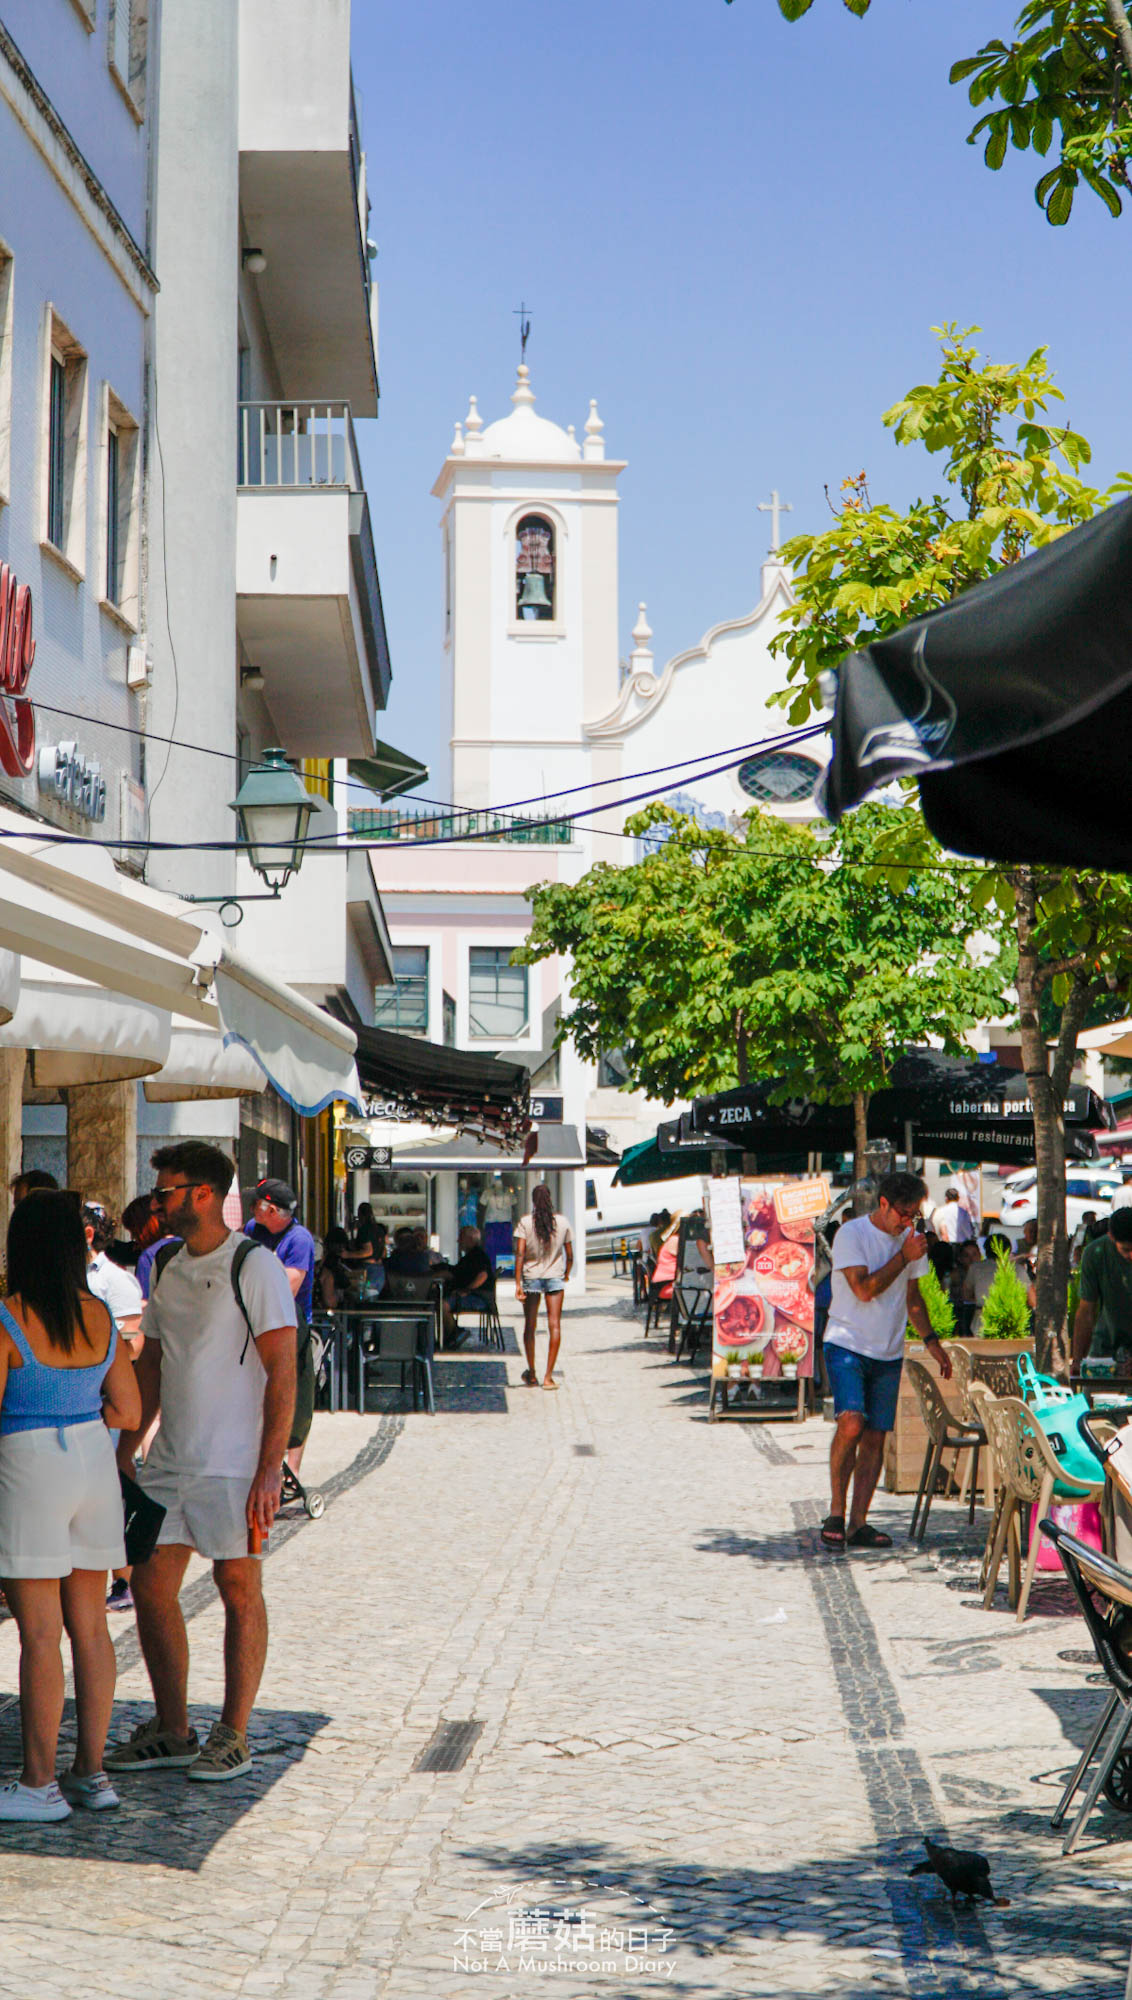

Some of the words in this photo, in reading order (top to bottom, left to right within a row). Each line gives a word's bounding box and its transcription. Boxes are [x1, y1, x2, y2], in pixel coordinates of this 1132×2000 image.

[950, 1099, 999, 1114] taberna
[719, 1107, 752, 1124] ZECA
[972, 1130, 1035, 1147] restaurant
